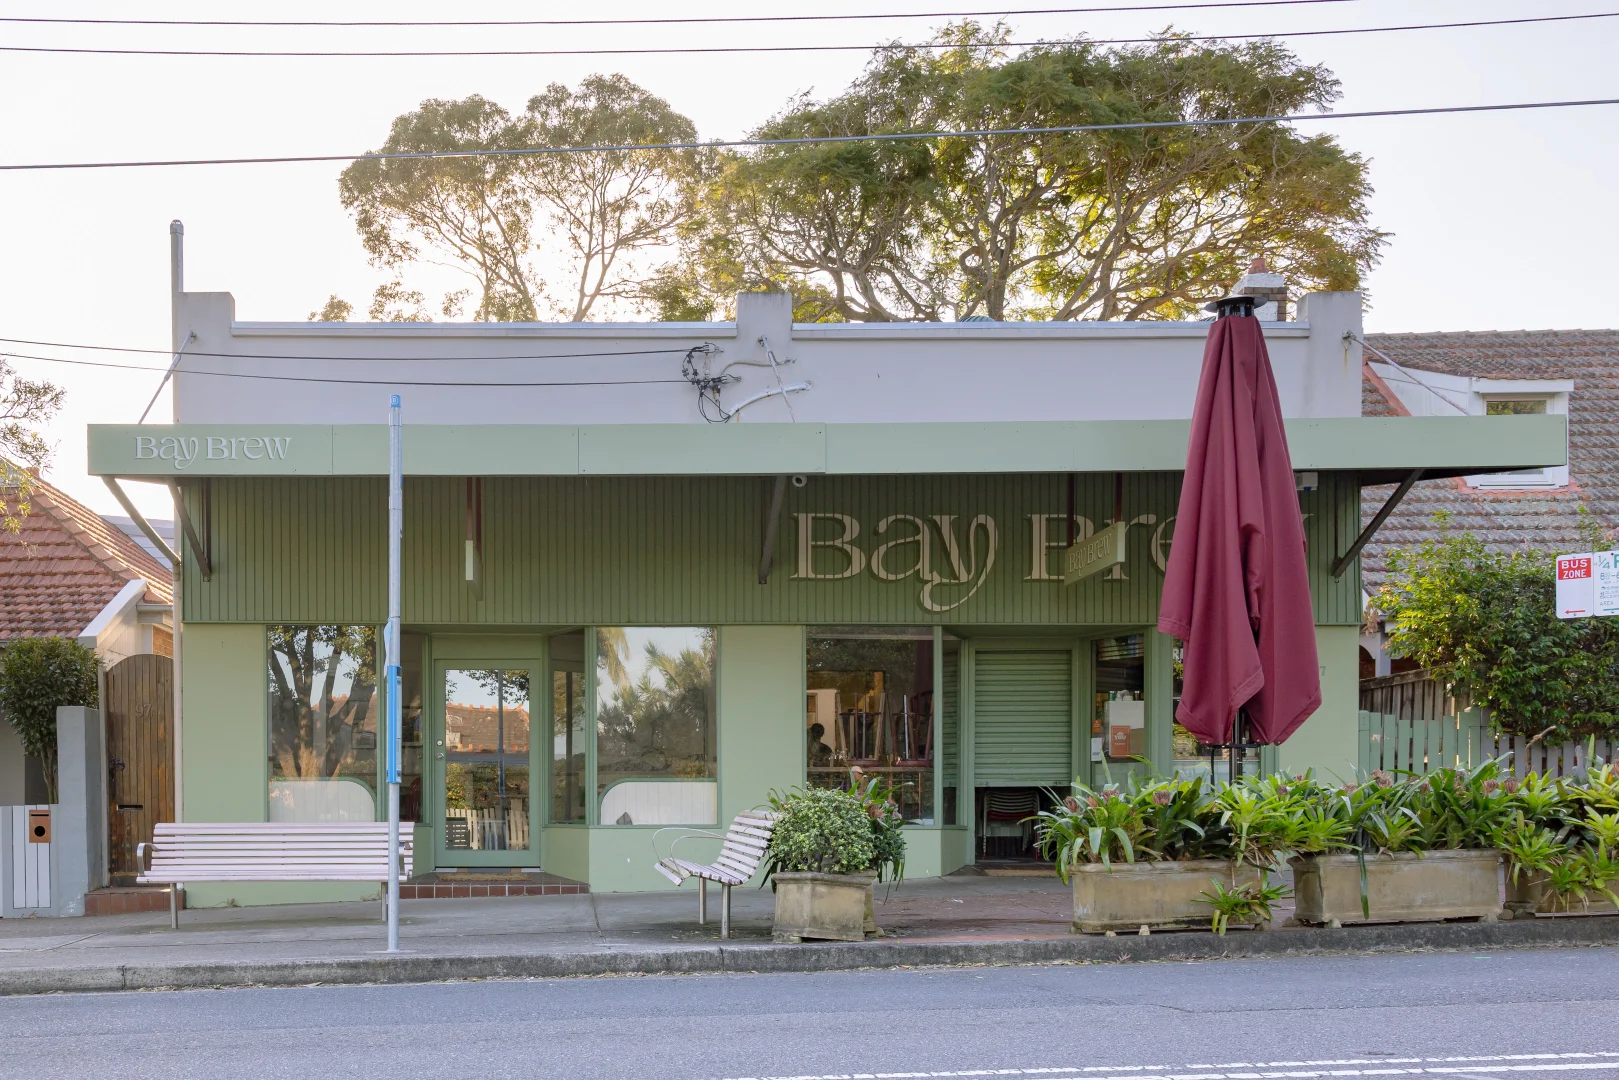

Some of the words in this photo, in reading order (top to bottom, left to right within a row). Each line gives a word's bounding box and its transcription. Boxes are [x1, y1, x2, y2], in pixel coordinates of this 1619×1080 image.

[135, 436, 199, 469] Bay
[206, 436, 292, 460] Brew
[790, 512, 999, 612] Bay
[1069, 547, 1087, 577] Bay
[1087, 533, 1112, 566] Brew
[1562, 559, 1588, 570] BUS
[1563, 569, 1587, 579] ZONE
